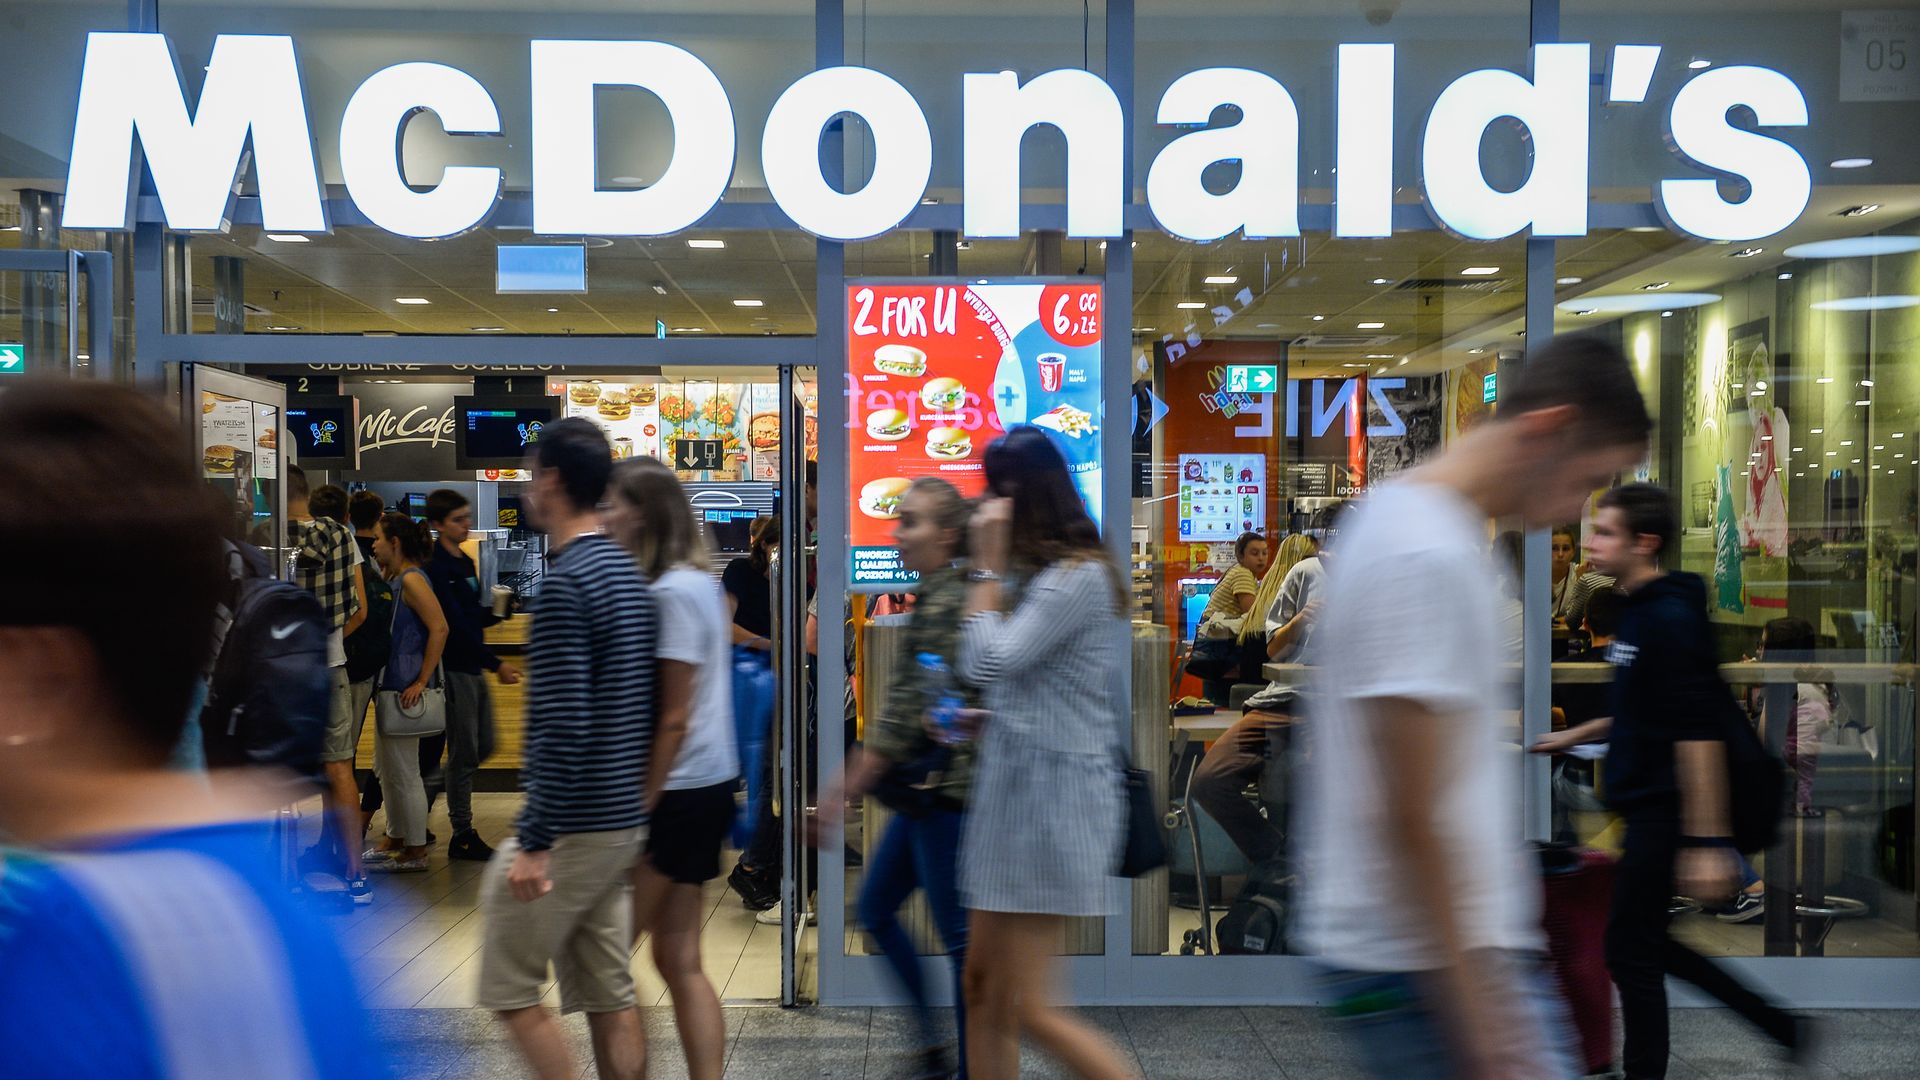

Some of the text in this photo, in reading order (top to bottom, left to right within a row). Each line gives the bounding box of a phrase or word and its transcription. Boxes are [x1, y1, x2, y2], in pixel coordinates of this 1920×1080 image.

[1866, 39, 1906, 72] 05
[60, 31, 1812, 243] McDonald's
[853, 286, 957, 337] 2 FOR U
[298, 377, 309, 392] 2
[505, 378, 513, 392] 1
[939, 463, 983, 471] CHEESEBURGER
[855, 550, 900, 560] DWORZEC
[860, 560, 898, 570] GALERIA
